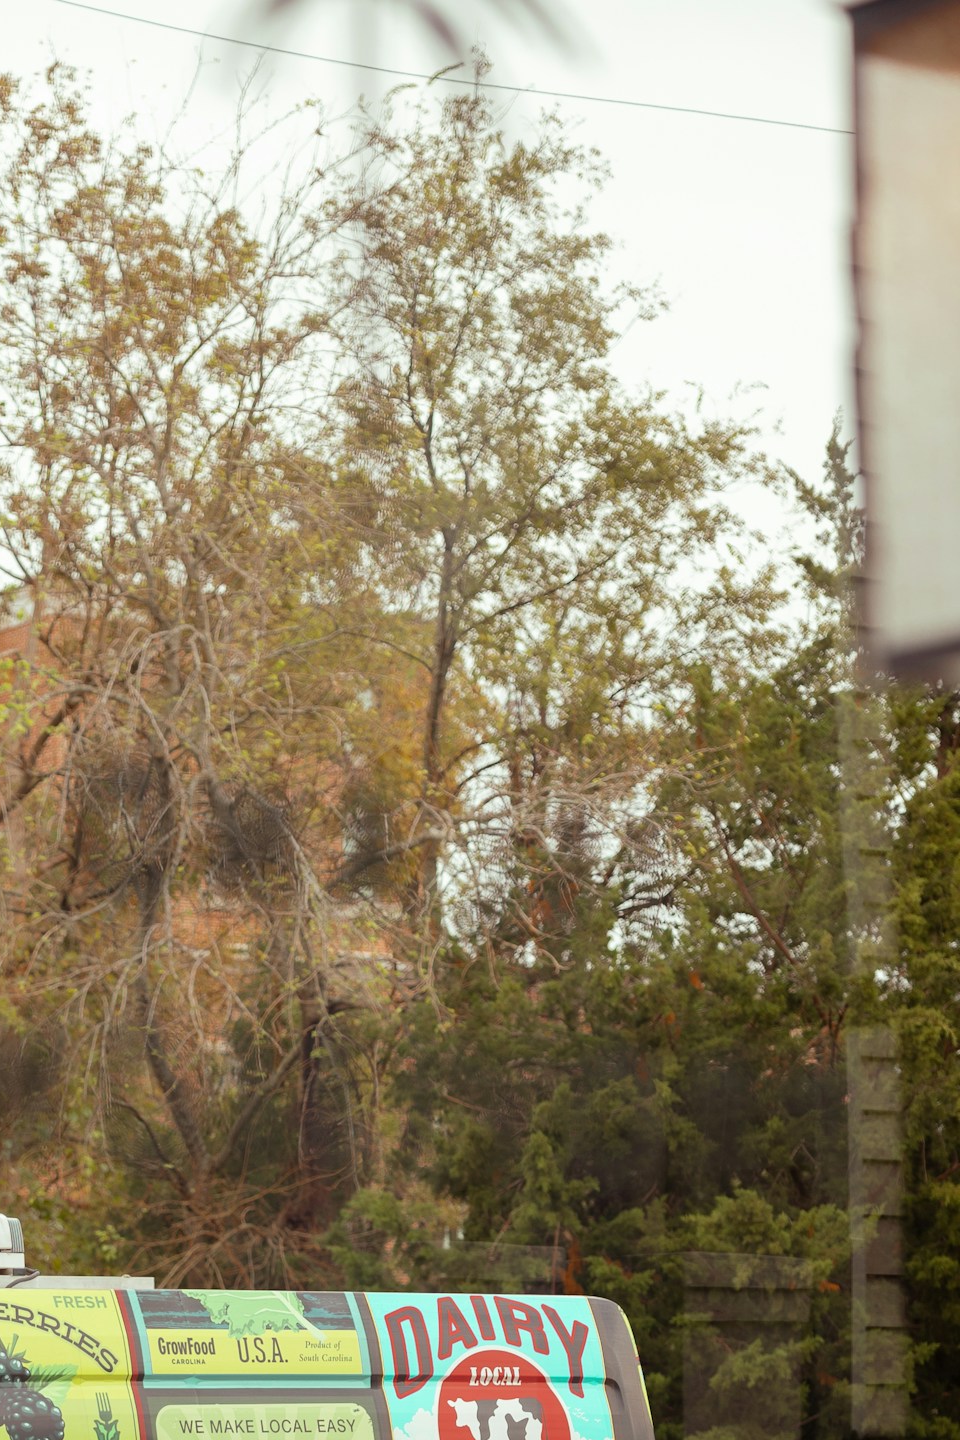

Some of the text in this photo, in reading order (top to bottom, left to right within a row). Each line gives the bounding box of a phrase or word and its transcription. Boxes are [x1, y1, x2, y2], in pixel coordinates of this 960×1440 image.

[53, 1295, 107, 1309] FRESH
[157, 1337, 216, 1355] GrowFood
[236, 1337, 289, 1363] U.S.A.
[305, 1340, 342, 1350] Product of
[384, 1295, 589, 1399] DAIRY
[299, 1353, 353, 1362] South Carolina
[469, 1366, 522, 1387] LOCAL
[179, 1418, 356, 1434] WE MAKE LOCAL EASY
